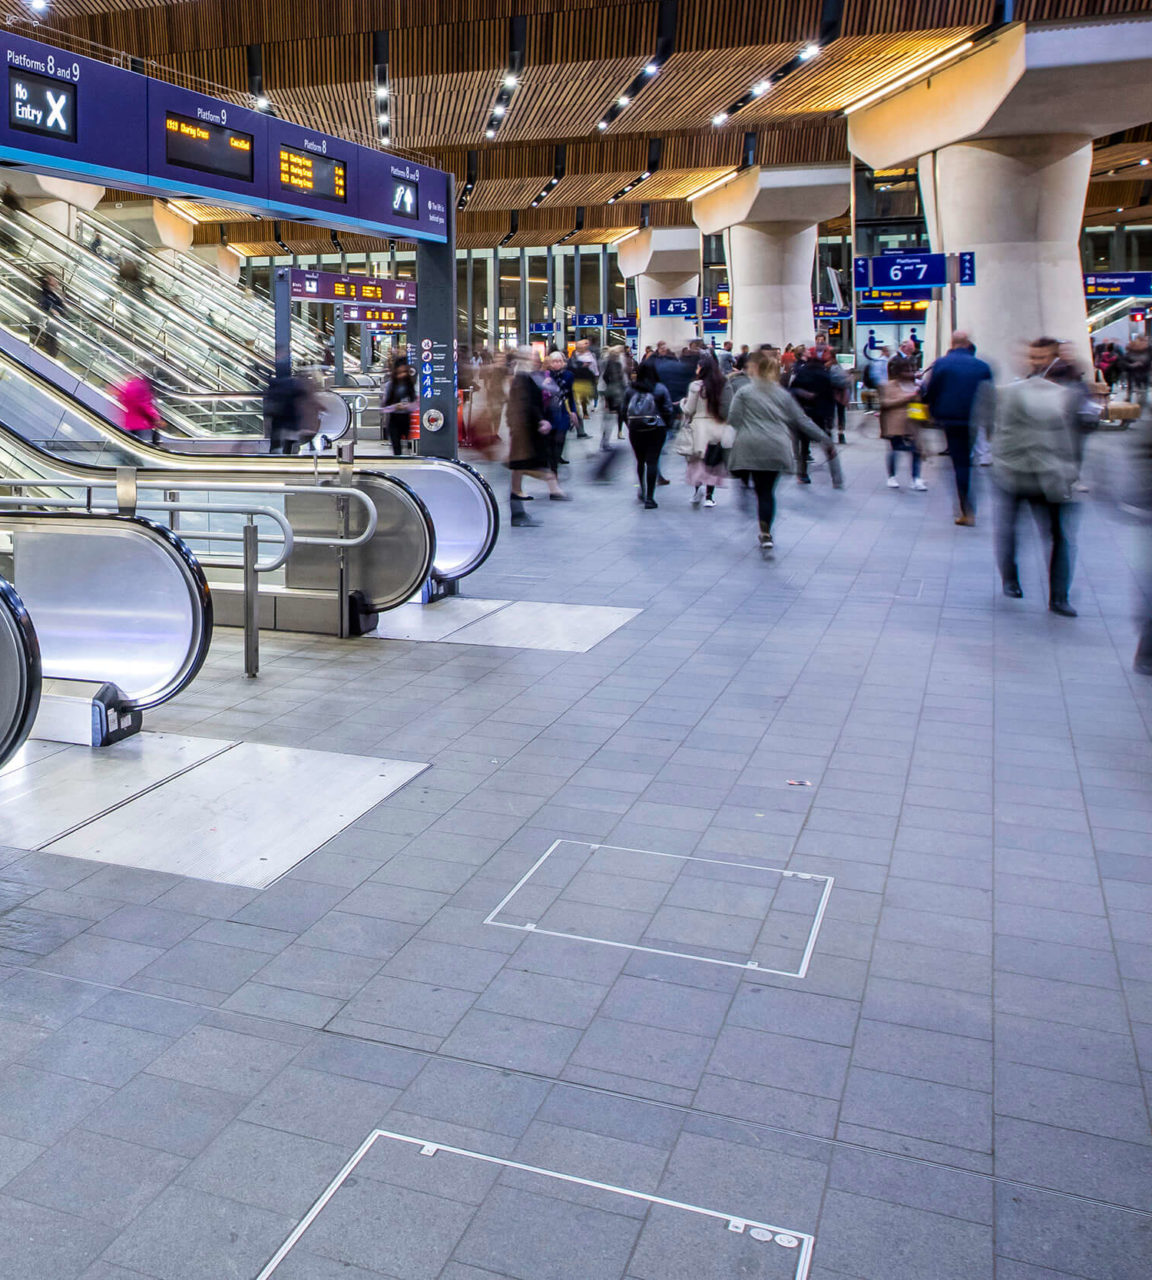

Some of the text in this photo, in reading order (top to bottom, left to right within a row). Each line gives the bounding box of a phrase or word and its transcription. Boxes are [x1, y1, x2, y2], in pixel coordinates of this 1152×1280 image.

[7, 49, 80, 81] Platforms 8 and 9
[15, 83, 28, 100] No
[15, 101, 43, 125] Entry
[197, 107, 227, 125] Platform 9
[304, 139, 327, 154] Platform 8
[415, 169, 420, 181] 9
[890, 265, 902, 281] 6
[915, 264, 928, 280] 7
[667, 304, 675, 312] 4
[680, 303, 688, 312] 5
